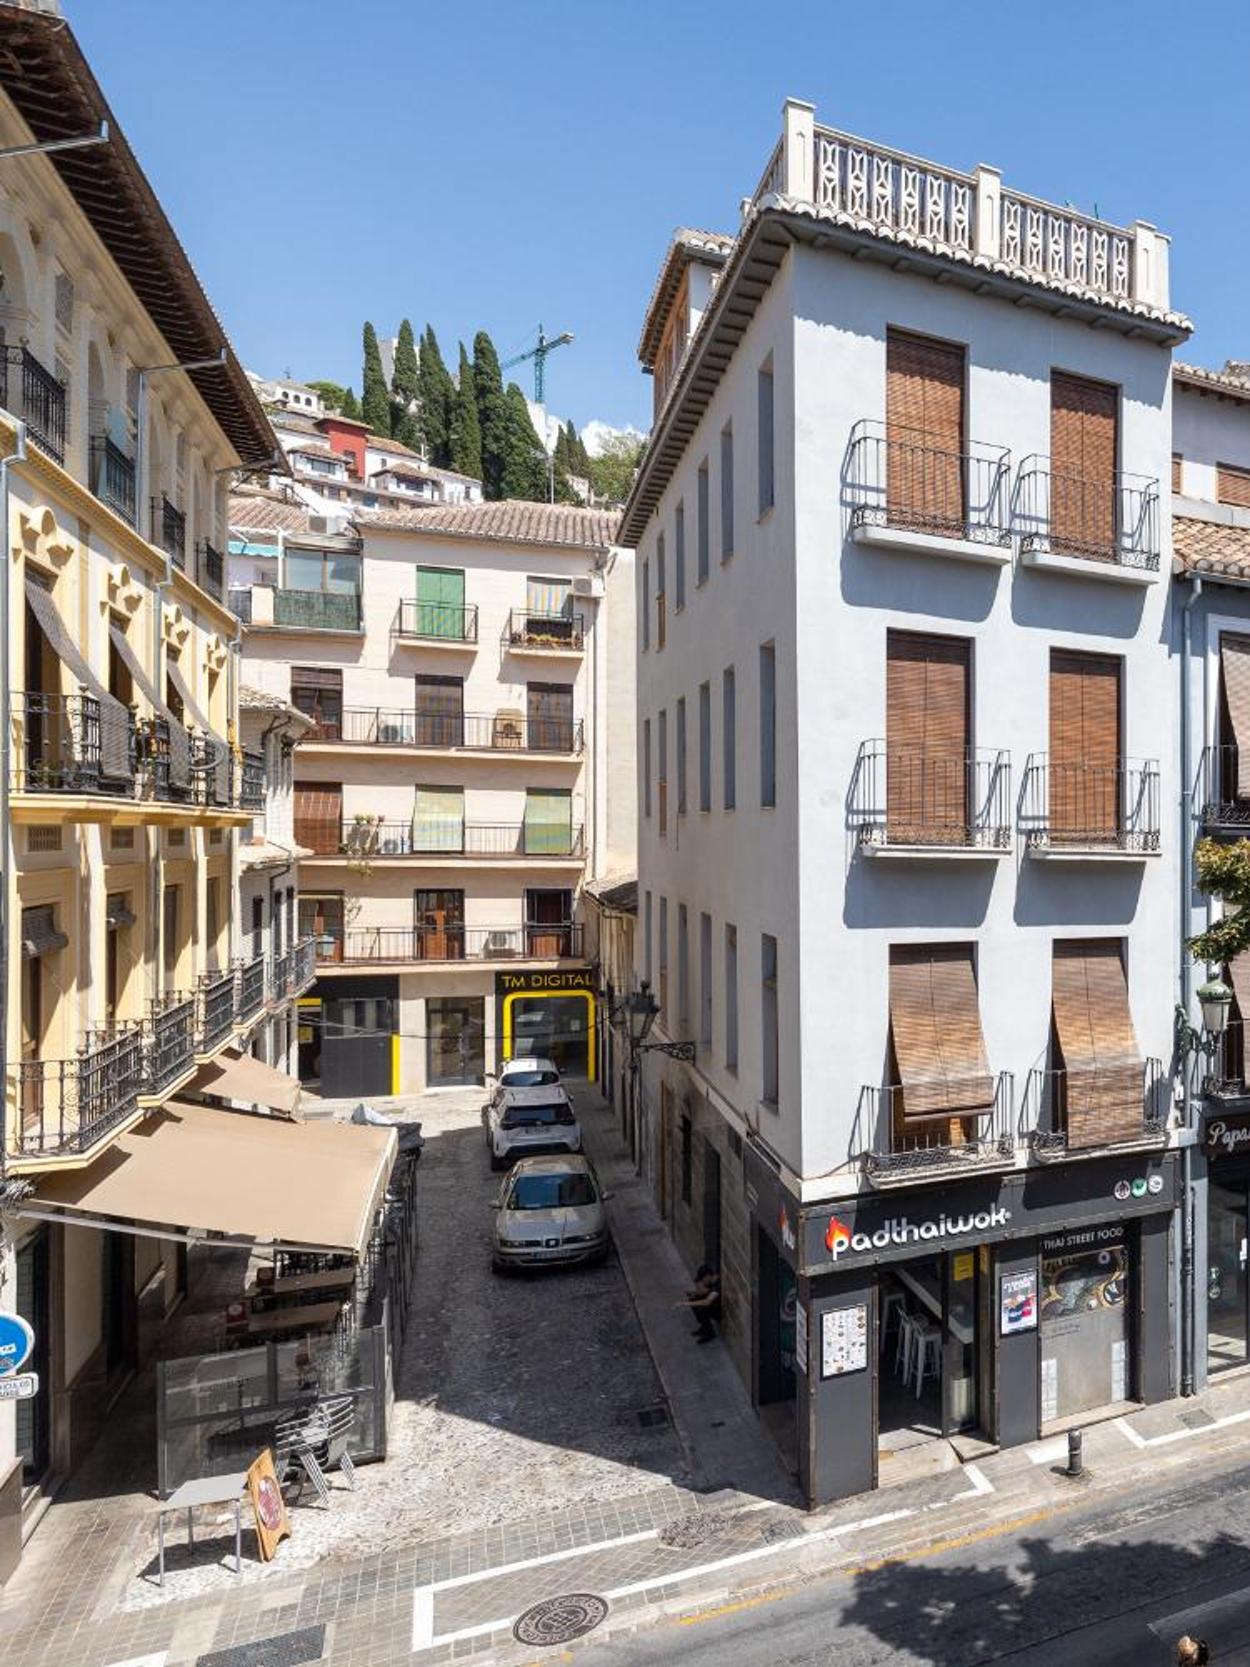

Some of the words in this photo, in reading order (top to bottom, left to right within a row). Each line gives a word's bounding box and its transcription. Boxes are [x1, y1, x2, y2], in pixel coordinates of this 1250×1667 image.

[501, 975, 525, 988] TM
[531, 973, 592, 987] DIGITAL
[831, 1203, 1006, 1261] padthaiwok
[1044, 1237, 1064, 1249] THAI
[1067, 1231, 1095, 1246] STREET
[1097, 1227, 1124, 1240] FOOD
